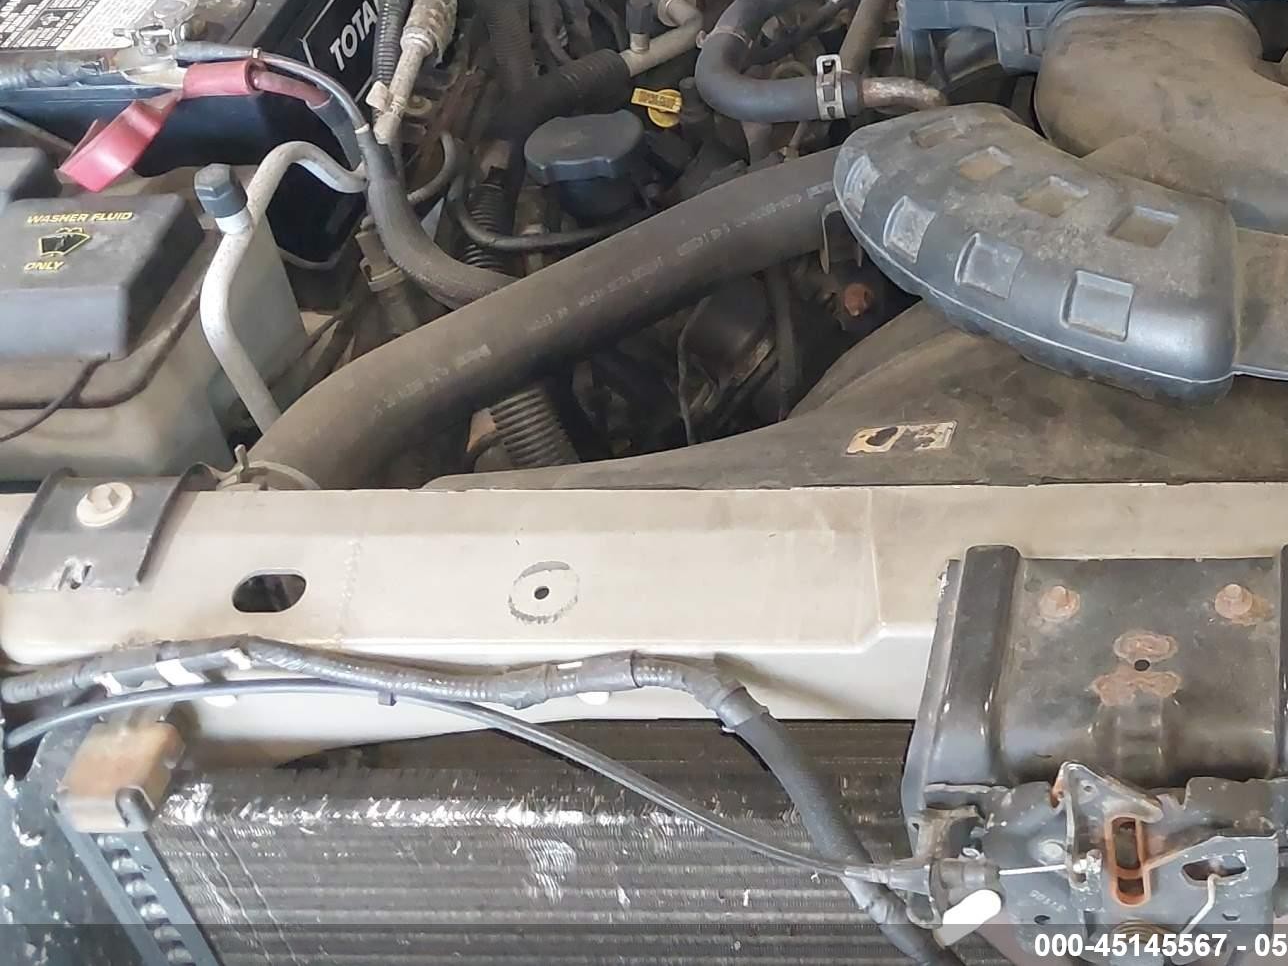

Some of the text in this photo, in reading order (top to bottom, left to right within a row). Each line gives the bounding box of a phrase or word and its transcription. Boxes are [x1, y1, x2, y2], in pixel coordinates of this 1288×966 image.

[27, 211, 134, 224] WASHER FLUID
[24, 260, 65, 272] ONLY
